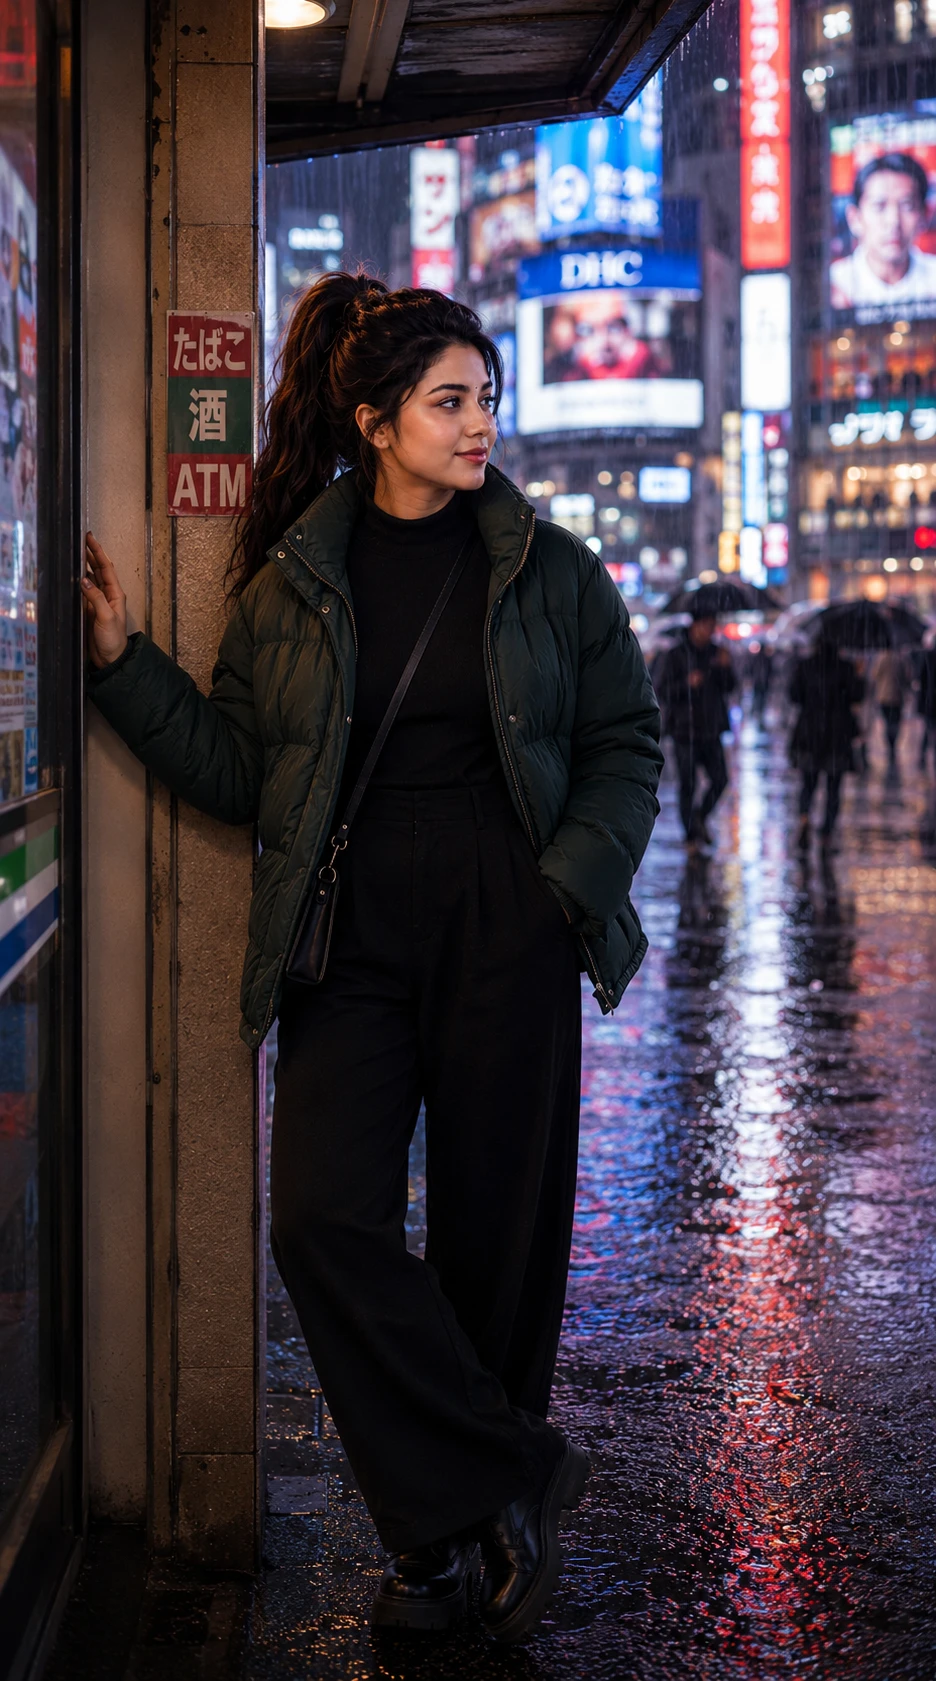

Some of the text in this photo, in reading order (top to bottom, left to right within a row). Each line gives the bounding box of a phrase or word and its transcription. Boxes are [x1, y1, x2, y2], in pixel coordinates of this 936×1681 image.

[559, 250, 643, 289] DHC
[173, 327, 246, 371] たばこ
[188, 388, 228, 442] 酒
[172, 463, 246, 508] ATM
